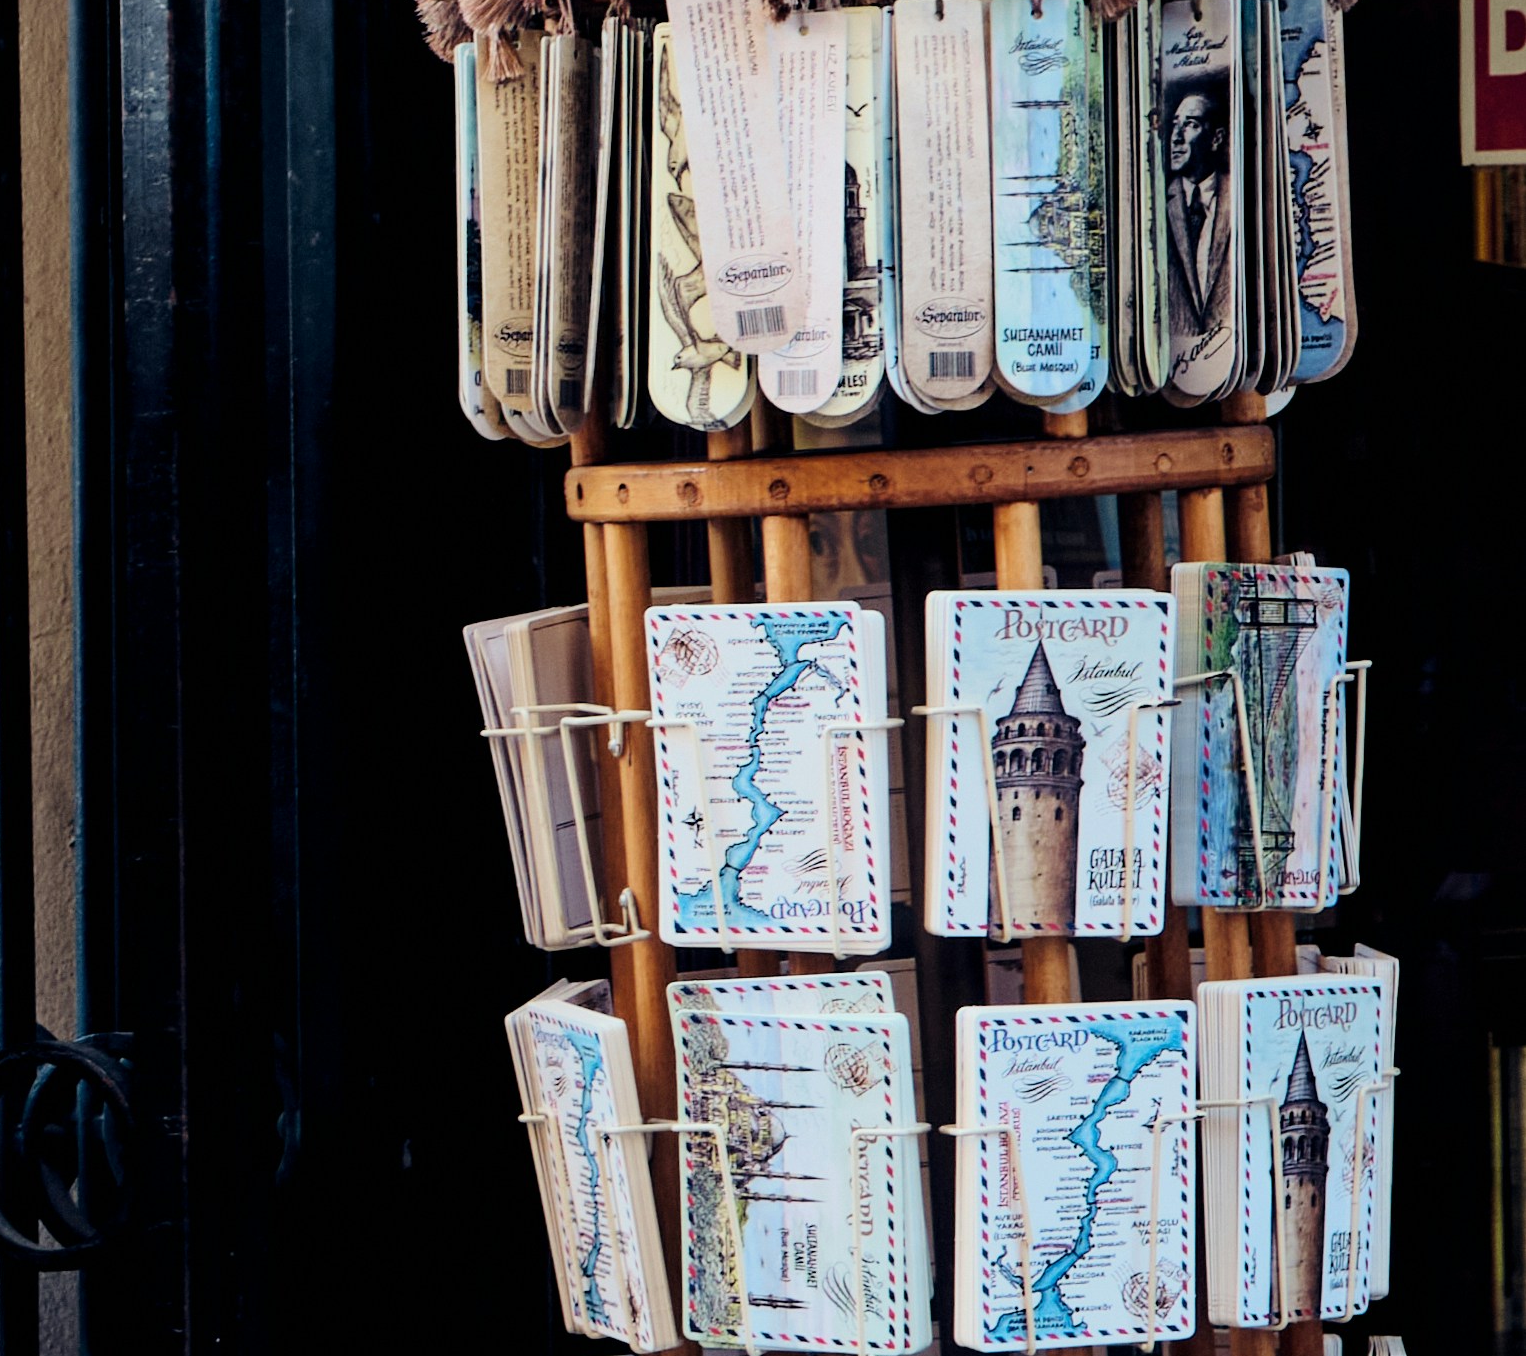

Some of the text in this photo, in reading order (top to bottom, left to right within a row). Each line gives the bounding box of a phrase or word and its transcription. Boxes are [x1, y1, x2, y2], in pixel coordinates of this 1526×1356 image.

[724, 261, 788, 288] Separator
[920, 305, 985, 328] Separator
[1065, 655, 1145, 686] İstanbul
[988, 1028, 1090, 1054] POSTCARD
